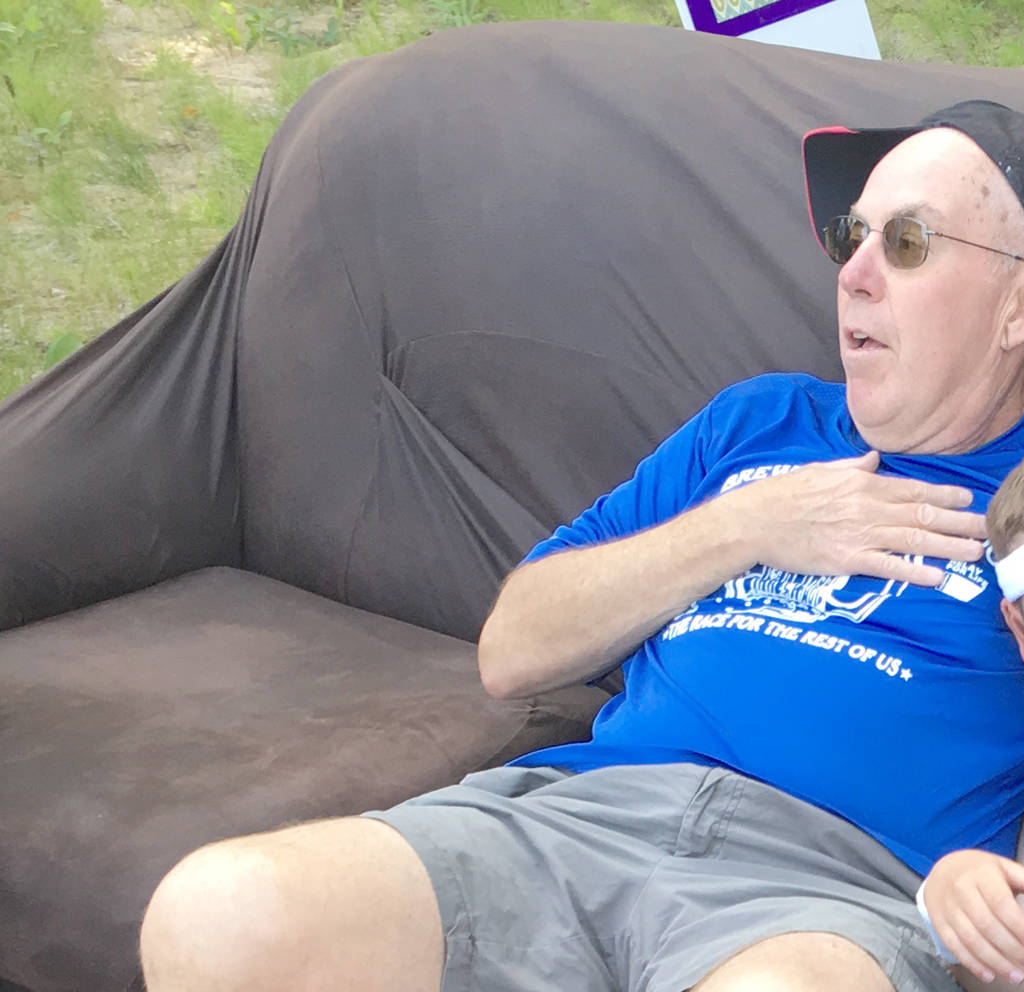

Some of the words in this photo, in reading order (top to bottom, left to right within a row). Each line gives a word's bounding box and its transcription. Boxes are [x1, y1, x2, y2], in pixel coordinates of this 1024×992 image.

[689, 614, 732, 632] RACE
[725, 614, 765, 632] FOR
[763, 621, 803, 641] THE
[800, 630, 850, 653] REST
[848, 645, 877, 662] OF
[875, 653, 902, 677] US
